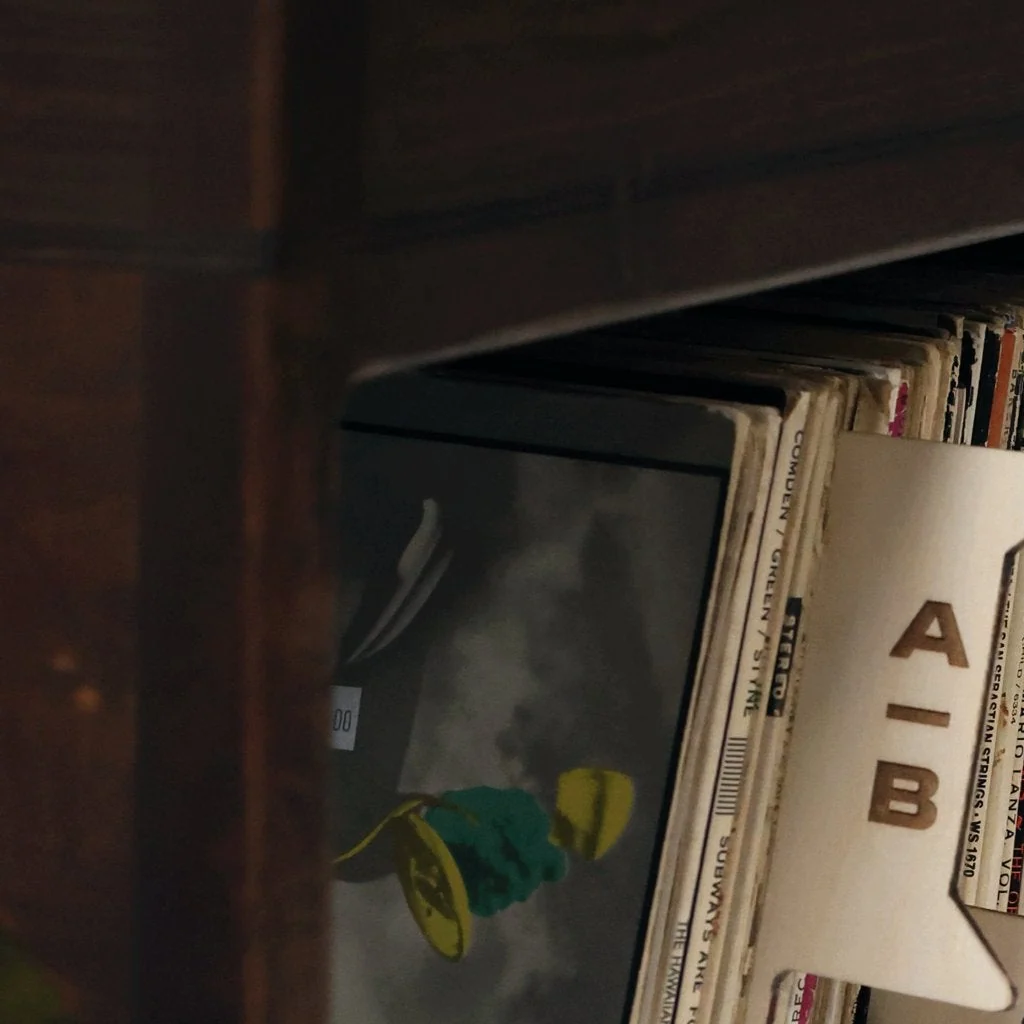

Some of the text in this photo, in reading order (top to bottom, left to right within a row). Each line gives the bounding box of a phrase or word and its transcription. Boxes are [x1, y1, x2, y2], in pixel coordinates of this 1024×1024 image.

[771, 613, 796, 699] STEREO
[867, 600, 970, 831] A B
[973, 745, 991, 807] STRINGS
[962, 845, 977, 877] 1670
[968, 820, 981, 842] WS
[702, 835, 731, 942] SUBWAYS
[693, 951, 709, 993] ARE
